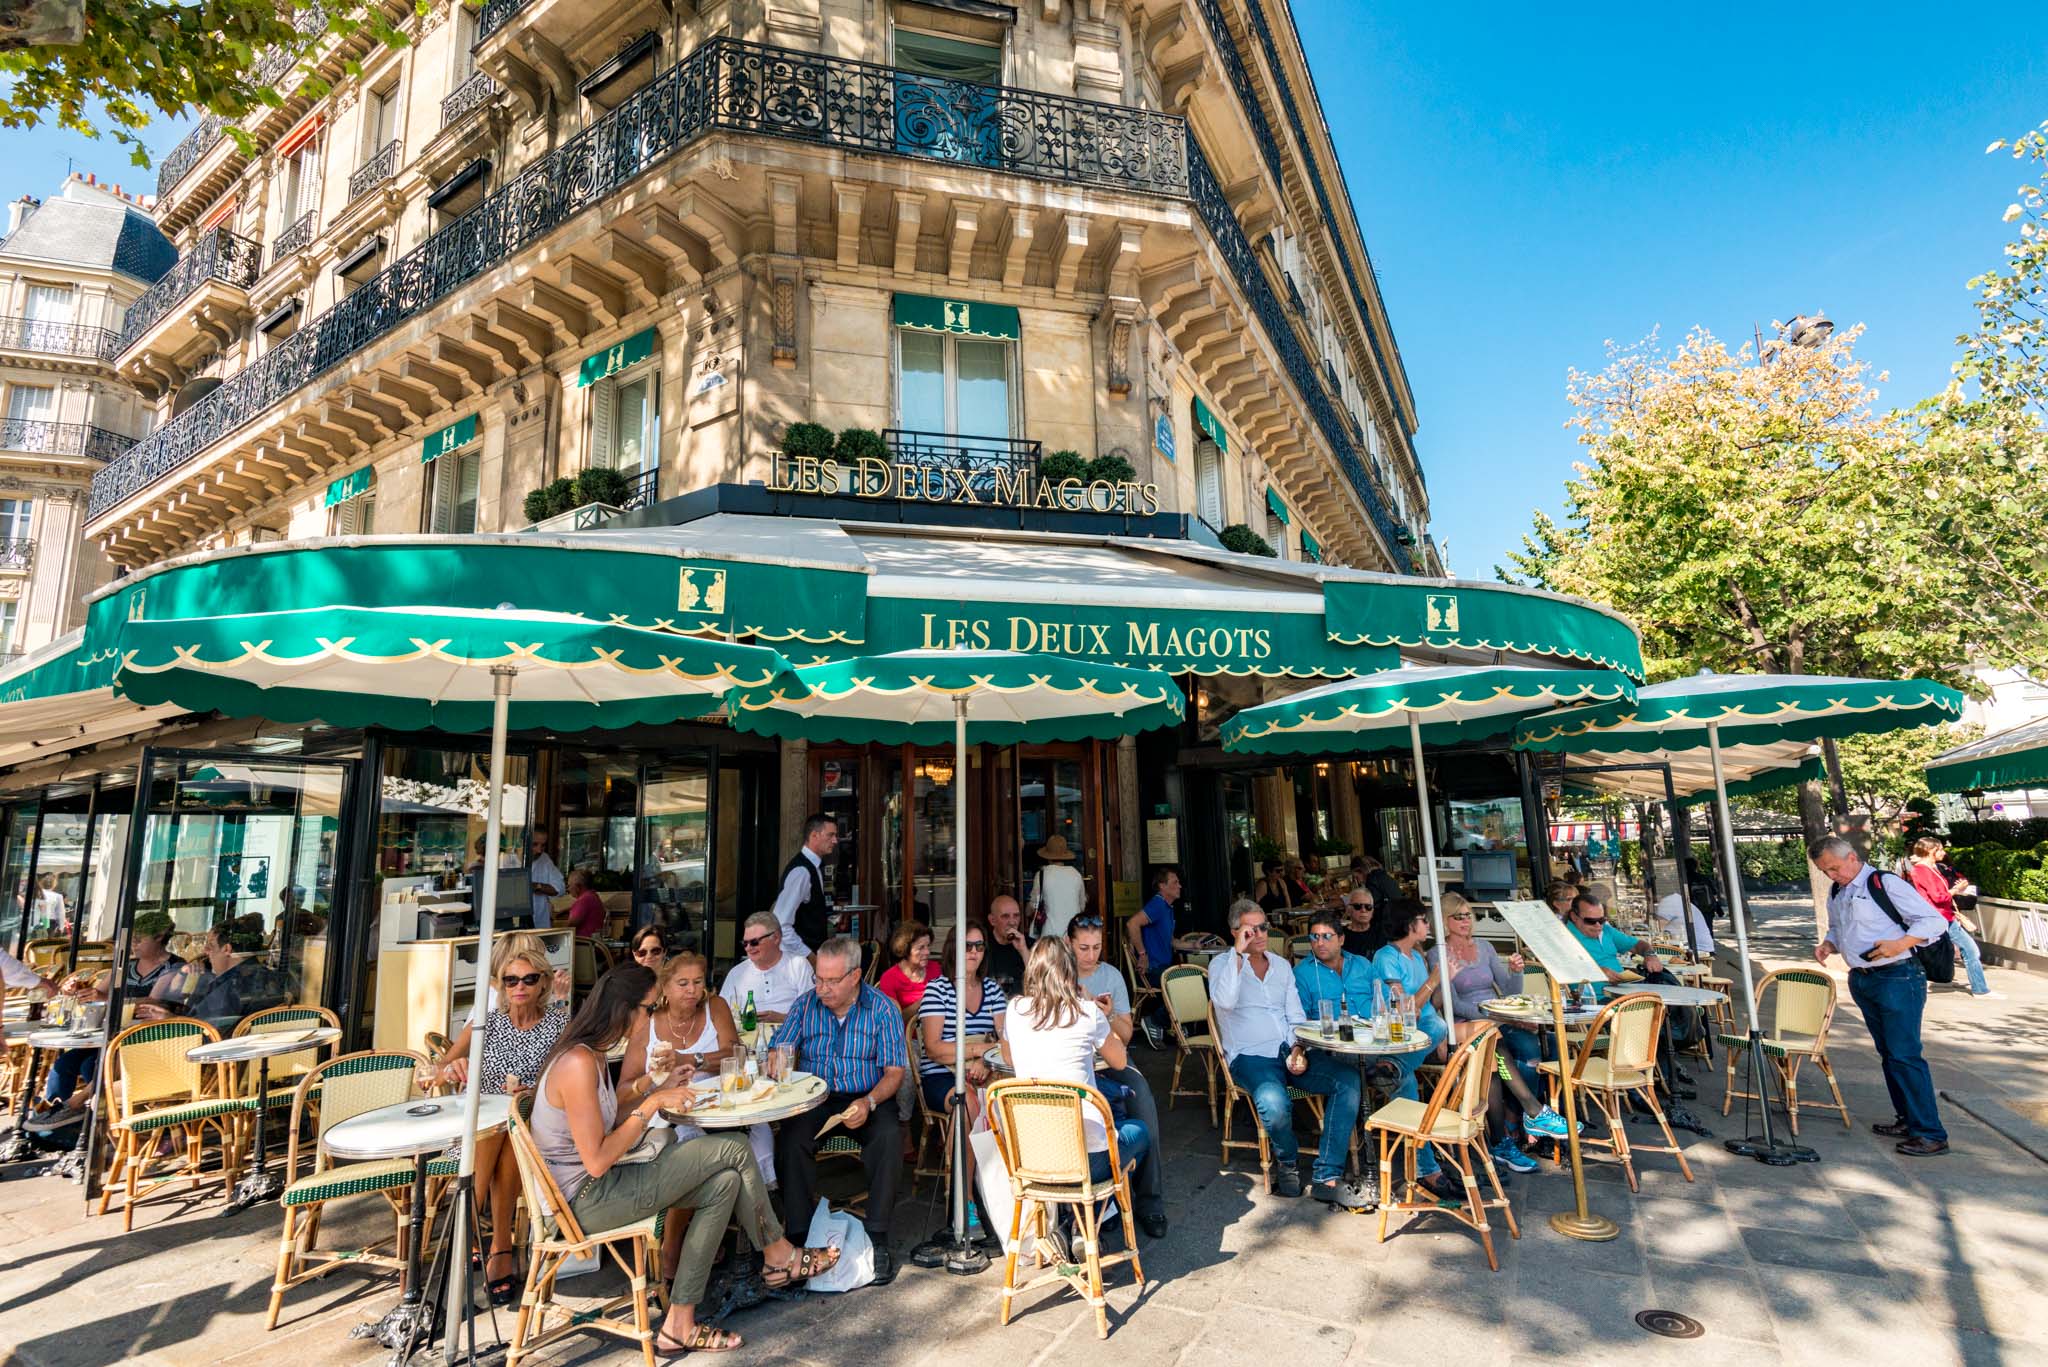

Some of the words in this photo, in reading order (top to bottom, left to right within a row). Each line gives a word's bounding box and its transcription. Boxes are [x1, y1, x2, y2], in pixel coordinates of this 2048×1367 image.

[766, 450, 841, 494] LES
[856, 457, 982, 504] DEUX
[992, 466, 1160, 516] MAGOTS
[920, 613, 991, 651] LES
[1007, 616, 1111, 655] DEUX
[1126, 621, 1272, 659] MAGOTS
